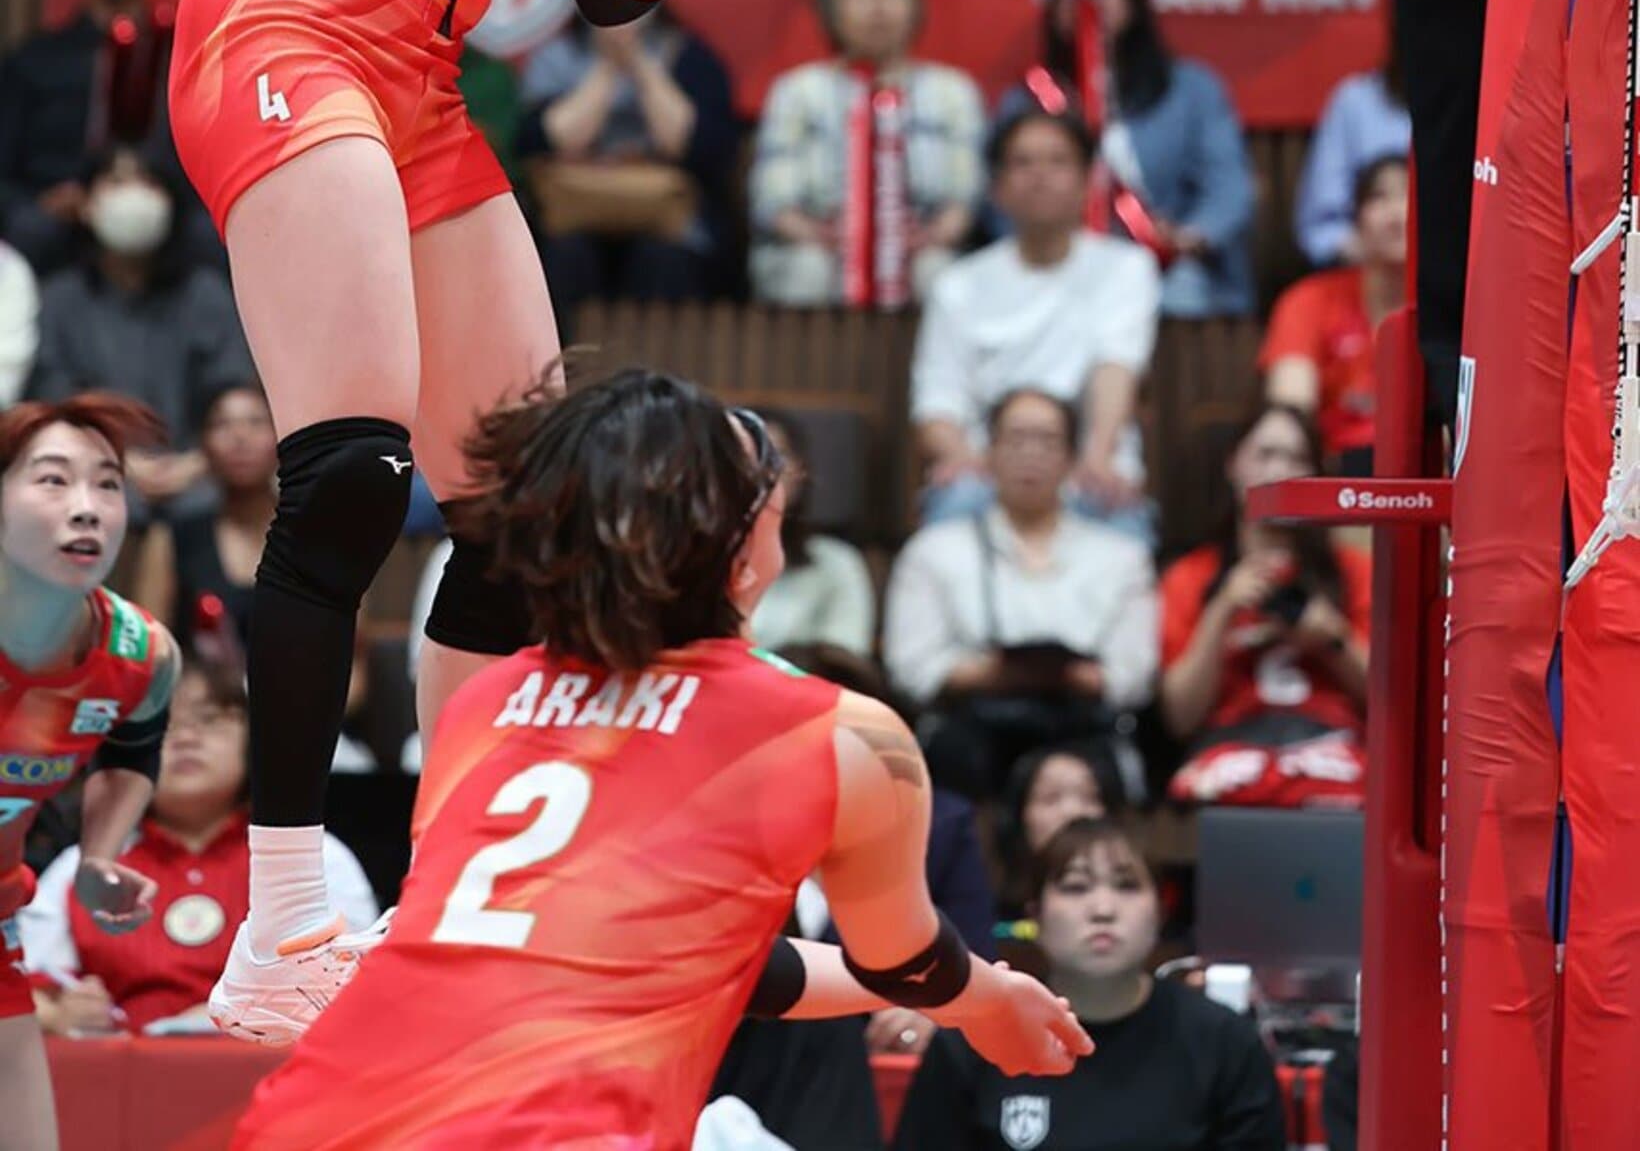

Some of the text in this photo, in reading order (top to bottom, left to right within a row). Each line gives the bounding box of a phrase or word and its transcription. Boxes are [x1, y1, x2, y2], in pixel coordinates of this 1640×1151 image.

[256, 72, 292, 123] 4
[1357, 490, 1434, 509] Senoh
[492, 670, 702, 735] ARAKI
[429, 760, 594, 949] 2
